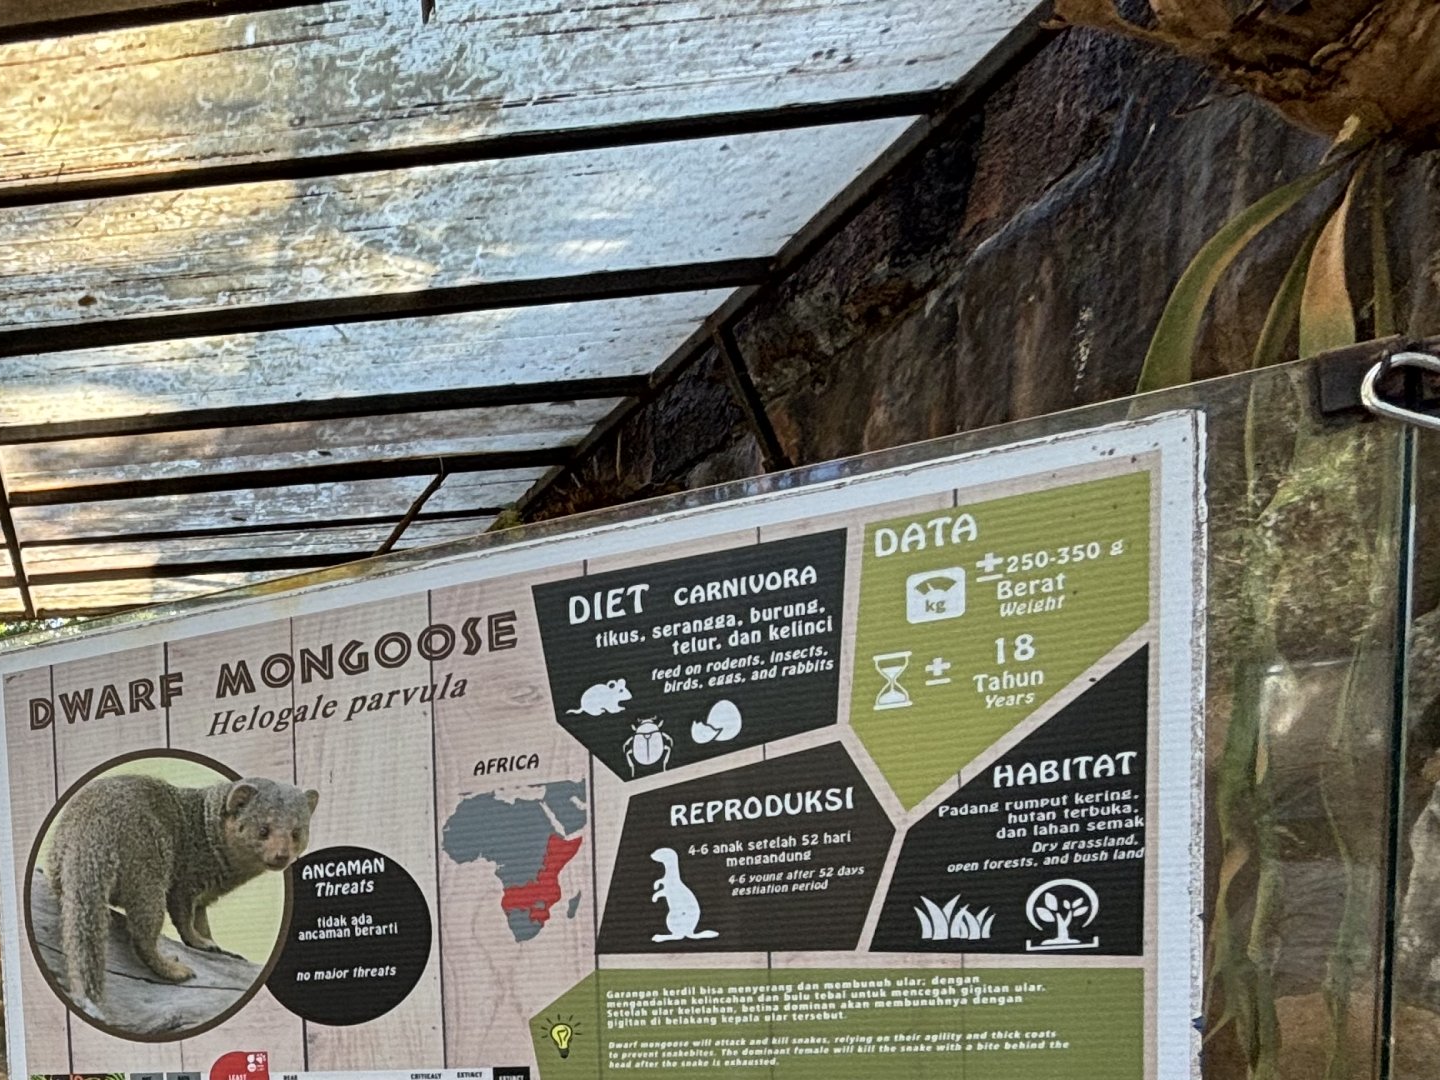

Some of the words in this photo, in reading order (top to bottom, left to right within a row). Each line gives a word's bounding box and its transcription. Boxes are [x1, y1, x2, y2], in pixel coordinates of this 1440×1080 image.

[874, 513, 978, 558] DATA
[1110, 539, 1124, 557] g
[568, 583, 650, 625] DIET
[674, 565, 818, 606] CARNIVORA
[997, 573, 1067, 600] Berat
[925, 600, 947, 614] kg
[1000, 595, 1067, 618] Weight
[728, 629, 761, 647] dan
[769, 615, 833, 641] kelinci
[995, 634, 1036, 665] 18
[29, 672, 184, 731] DWARF
[216, 610, 518, 699] MONGOOSE
[651, 664, 682, 680] feed
[685, 664, 702, 676] on
[751, 665, 777, 681] and
[781, 659, 834, 677] rabbits
[973, 670, 1044, 694] Tahun
[206, 694, 338, 737] Helogale
[344, 673, 468, 721] parvula
[985, 691, 1035, 709] Years
[473, 753, 540, 777] AFRICA
[993, 751, 1137, 789] HABITAT
[671, 786, 854, 826] REPRODUKSI
[938, 801, 999, 818] Padang
[1005, 795, 1069, 812] rumput
[1008, 809, 1057, 825] hutan
[996, 827, 1027, 840] dan
[1033, 821, 1080, 837] lahan
[1086, 815, 1145, 832] semak
[688, 843, 709, 856] 4-6
[712, 840, 744, 854] anak
[748, 835, 796, 851] setelah
[801, 833, 819, 846] 52
[824, 830, 852, 844] hari
[1031, 841, 1059, 854] Dry
[302, 857, 385, 881] ANCAMAN
[726, 850, 812, 867] mengandung
[947, 863, 979, 874] open
[1042, 853, 1069, 867] and
[1073, 850, 1108, 864] bush
[1113, 847, 1145, 861] land
[728, 873, 746, 885] 4-6
[748, 871, 784, 884] young
[786, 868, 816, 880] after
[819, 867, 834, 878] 52
[837, 865, 865, 877] days
[791, 879, 829, 892] period
[315, 879, 374, 897] Threats
[298, 928, 350, 941] ancaman
[355, 922, 398, 937] berarti
[317, 915, 347, 928] tidak
[351, 913, 373, 926] ada
[296, 971, 311, 981] no
[314, 968, 349, 980] major
[353, 965, 397, 978] threats
[606, 990, 659, 1000] Garangan
[663, 986, 696, 997] kerdil
[700, 986, 724, 995] bisa
[727, 984, 793, 995] menyerang
[797, 981, 819, 991] dan
[824, 978, 891, 989] membunuh
[931, 976, 979, 986] dengan
[606, 997, 687, 1009] mengandalkan
[691, 994, 753, 1005] kelincahan
[757, 993, 779, 1003] dan
[784, 991, 810, 1001] bulu
[815, 990, 846, 1000] tebal
[851, 988, 886, 998] untuk
[891, 986, 956, 997] mencegah
[961, 984, 1009, 996] gigitan
[606, 1008, 648, 1018] Setelah
[651, 1007, 674, 1016] ular
[742, 1004, 779, 1013] betina
[783, 1002, 836, 1012] dominan
[841, 1000, 870, 1009] akan
[875, 997, 968, 1008] membunuhnya
[973, 995, 1022, 1006] dengan
[607, 1018, 646, 1029] gigitan
[650, 1017, 661, 1026] di
[665, 1015, 717, 1026] belakang
[721, 1013, 760, 1025] kepala
[765, 1012, 788, 1022] ular
[609, 1040, 638, 1049] Dwarf
[641, 1041, 689, 1050] mongoose
[692, 1038, 712, 1047] will
[715, 1038, 746, 1046] attack
[749, 1037, 768, 1046] and
[772, 1036, 789, 1045] kill
[834, 1035, 873, 1045] relying
[876, 1035, 890, 1043] on
[894, 1033, 921, 1042] their
[924, 1032, 962, 1042] agility
[966, 1031, 988, 1040] and
[991, 1030, 1020, 1039] thick
[1024, 1030, 1057, 1039] coats
[609, 1050, 618, 1059] to
[621, 1050, 658, 1060] prevent
[722, 1048, 738, 1056] The
[742, 1047, 790, 1056] dominant
[794, 1046, 829, 1055] female
[833, 1045, 854, 1054] will
[857, 1045, 875, 1054] kill
[879, 1044, 897, 1053] the
[900, 1043, 932, 1053] snake
[936, 1043, 962, 1052] with
[977, 1042, 1000, 1051] bite
[1004, 1040, 1046, 1050] behind
[1049, 1040, 1070, 1049] the
[456, 1071, 483, 1079] EXTINCT
[609, 1060, 632, 1069] head
[635, 1060, 659, 1069] after
[662, 1060, 677, 1068] the
[681, 1059, 709, 1068] snake
[712, 1058, 720, 1067] is
